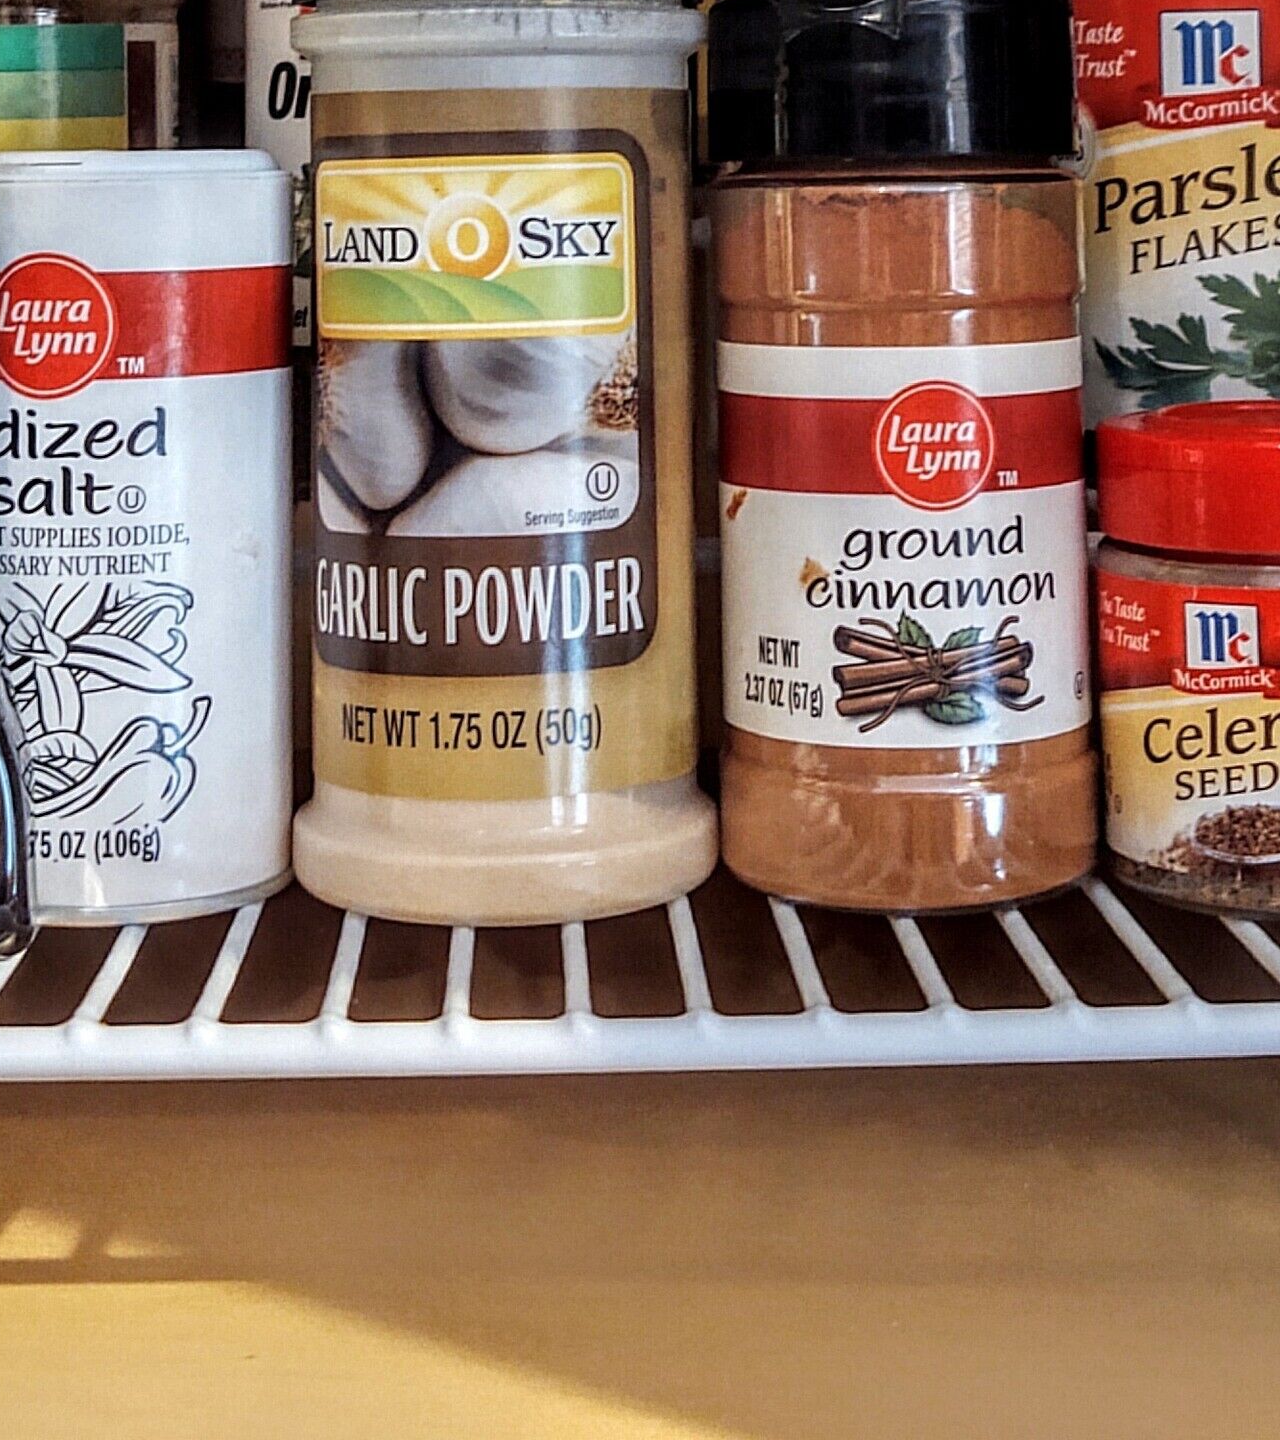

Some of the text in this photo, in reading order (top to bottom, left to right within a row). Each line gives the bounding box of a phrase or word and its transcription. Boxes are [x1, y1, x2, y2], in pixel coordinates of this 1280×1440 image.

[1075, 21, 1124, 45] Taste
[1144, 91, 1280, 124] McCormick
[324, 217, 617, 263] LAND O SKY
[14, 327, 97, 364] Lynn
[887, 414, 976, 452] Laura
[906, 447, 981, 481] Lynn
[525, 505, 619, 528] Serving Suggestion
[10, 526, 100, 548] SUPPLIES
[108, 523, 190, 547] IODIDE,
[840, 515, 1024, 571] ground
[58, 551, 171, 576] NUTRIENT
[316, 556, 645, 645] GARLIC POWDER
[805, 568, 1056, 610] cinnamon
[1113, 595, 1146, 622] Taste
[759, 636, 800, 668] NET WT
[1174, 668, 1275, 689] McCormick
[769, 678, 784, 707] OZ
[789, 681, 823, 717] (67g)
[342, 703, 602, 755] NET WT 1.75 OZ (50g)
[1175, 761, 1279, 801] SEED
[60, 830, 86, 858] OZ
[94, 827, 160, 864] (106g)
